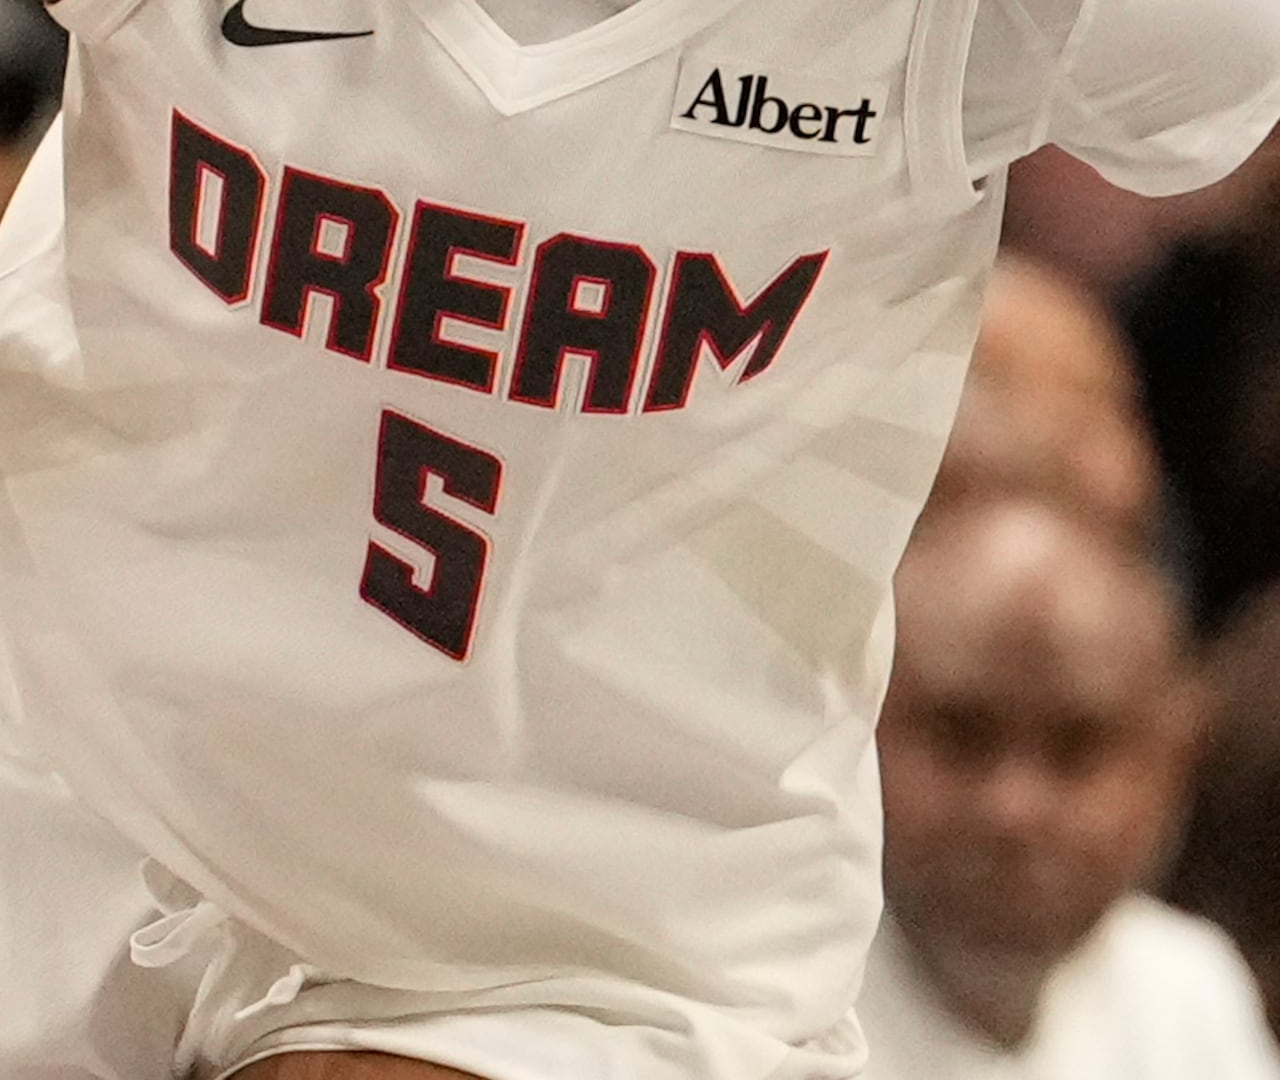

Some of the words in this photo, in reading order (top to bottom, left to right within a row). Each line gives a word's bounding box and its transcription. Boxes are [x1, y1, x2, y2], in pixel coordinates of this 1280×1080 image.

[679, 66, 878, 145] Albert
[168, 106, 831, 415] DREAM
[358, 407, 504, 663] 5
